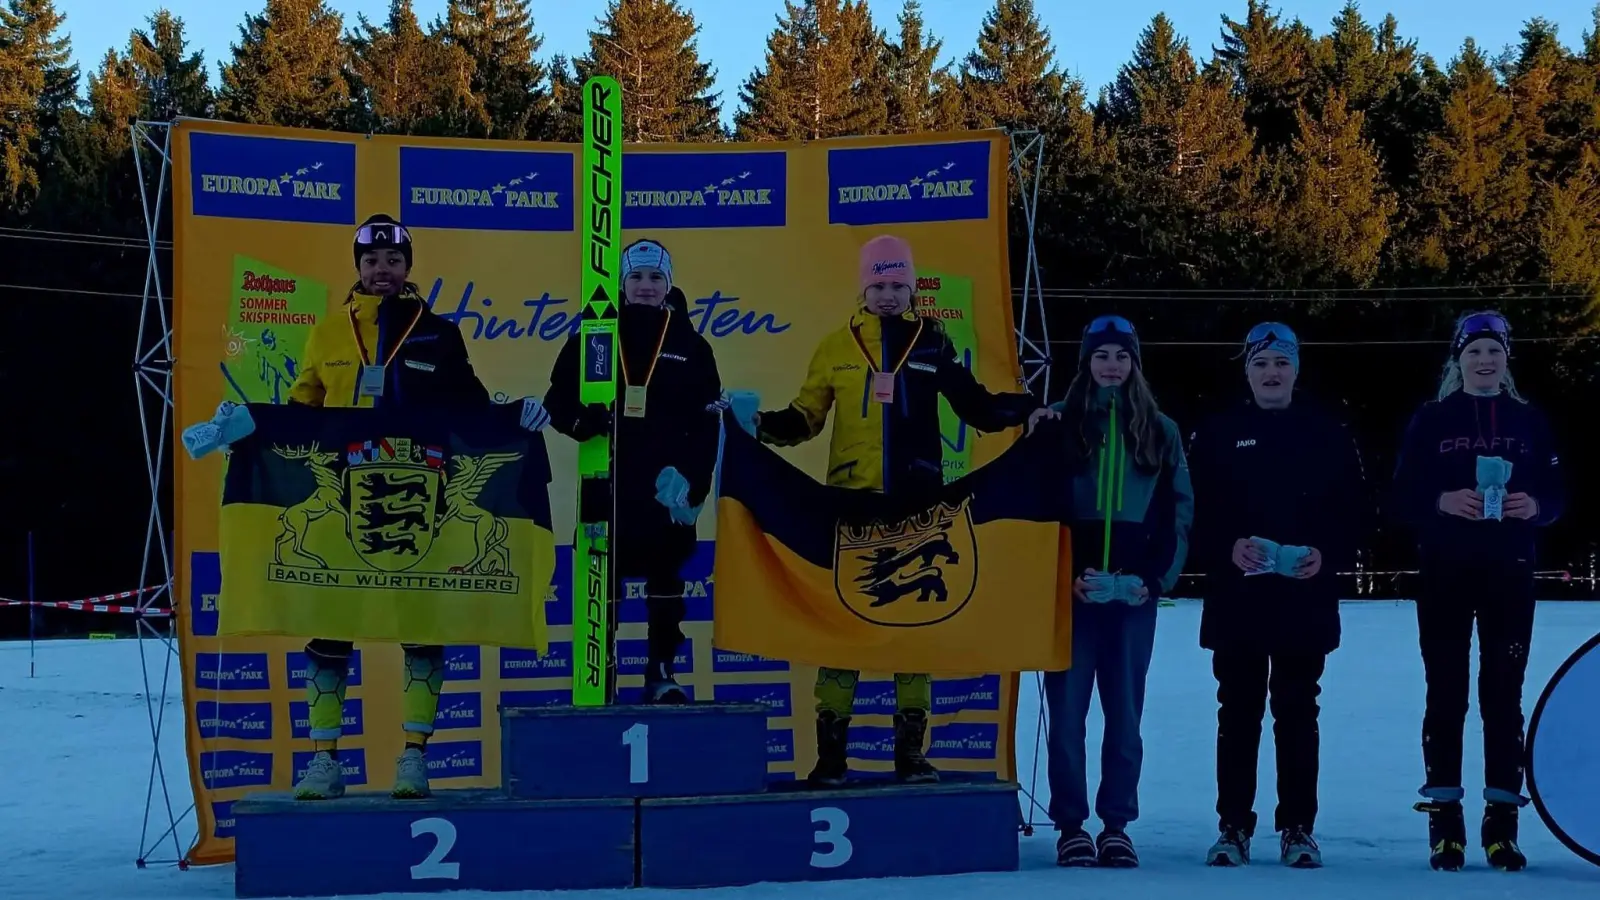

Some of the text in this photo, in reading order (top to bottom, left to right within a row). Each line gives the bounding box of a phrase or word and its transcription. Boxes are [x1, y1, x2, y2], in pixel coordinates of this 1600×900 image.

[591, 82, 612, 279] FISCHER
[201, 174, 342, 201] EUROPA PARK
[838, 179, 975, 204] EUROPA PARK
[410, 186, 560, 209] EUROPA PARK
[624, 188, 772, 207] EUROPA PARK
[241, 270, 297, 295] Rothaus
[240, 297, 288, 310] SOMMER
[240, 311, 316, 325] SKISPRINGEN
[1236, 439, 1257, 449] JAKO
[1439, 436, 1516, 453] CRAFT
[275, 568, 513, 591] BADEN WÜRTTEMBERG
[625, 580, 708, 600] EUPA
[586, 547, 602, 688] FISCHER
[449, 661, 474, 671] PARK
[503, 659, 567, 669] EUROPA PARK
[621, 656, 649, 665] EURO
[240, 670, 264, 680] PARK
[853, 697, 877, 706] ROPA
[969, 691, 993, 700] PARK
[450, 708, 475, 718] PARK
[242, 720, 266, 730] PARK
[766, 744, 788, 753] ARK
[931, 739, 993, 749] UROPA PARK
[622, 723, 649, 783] 1
[451, 758, 475, 768] PARK
[239, 767, 265, 776] PARK
[809, 806, 853, 868] 3
[410, 817, 460, 880] 2
